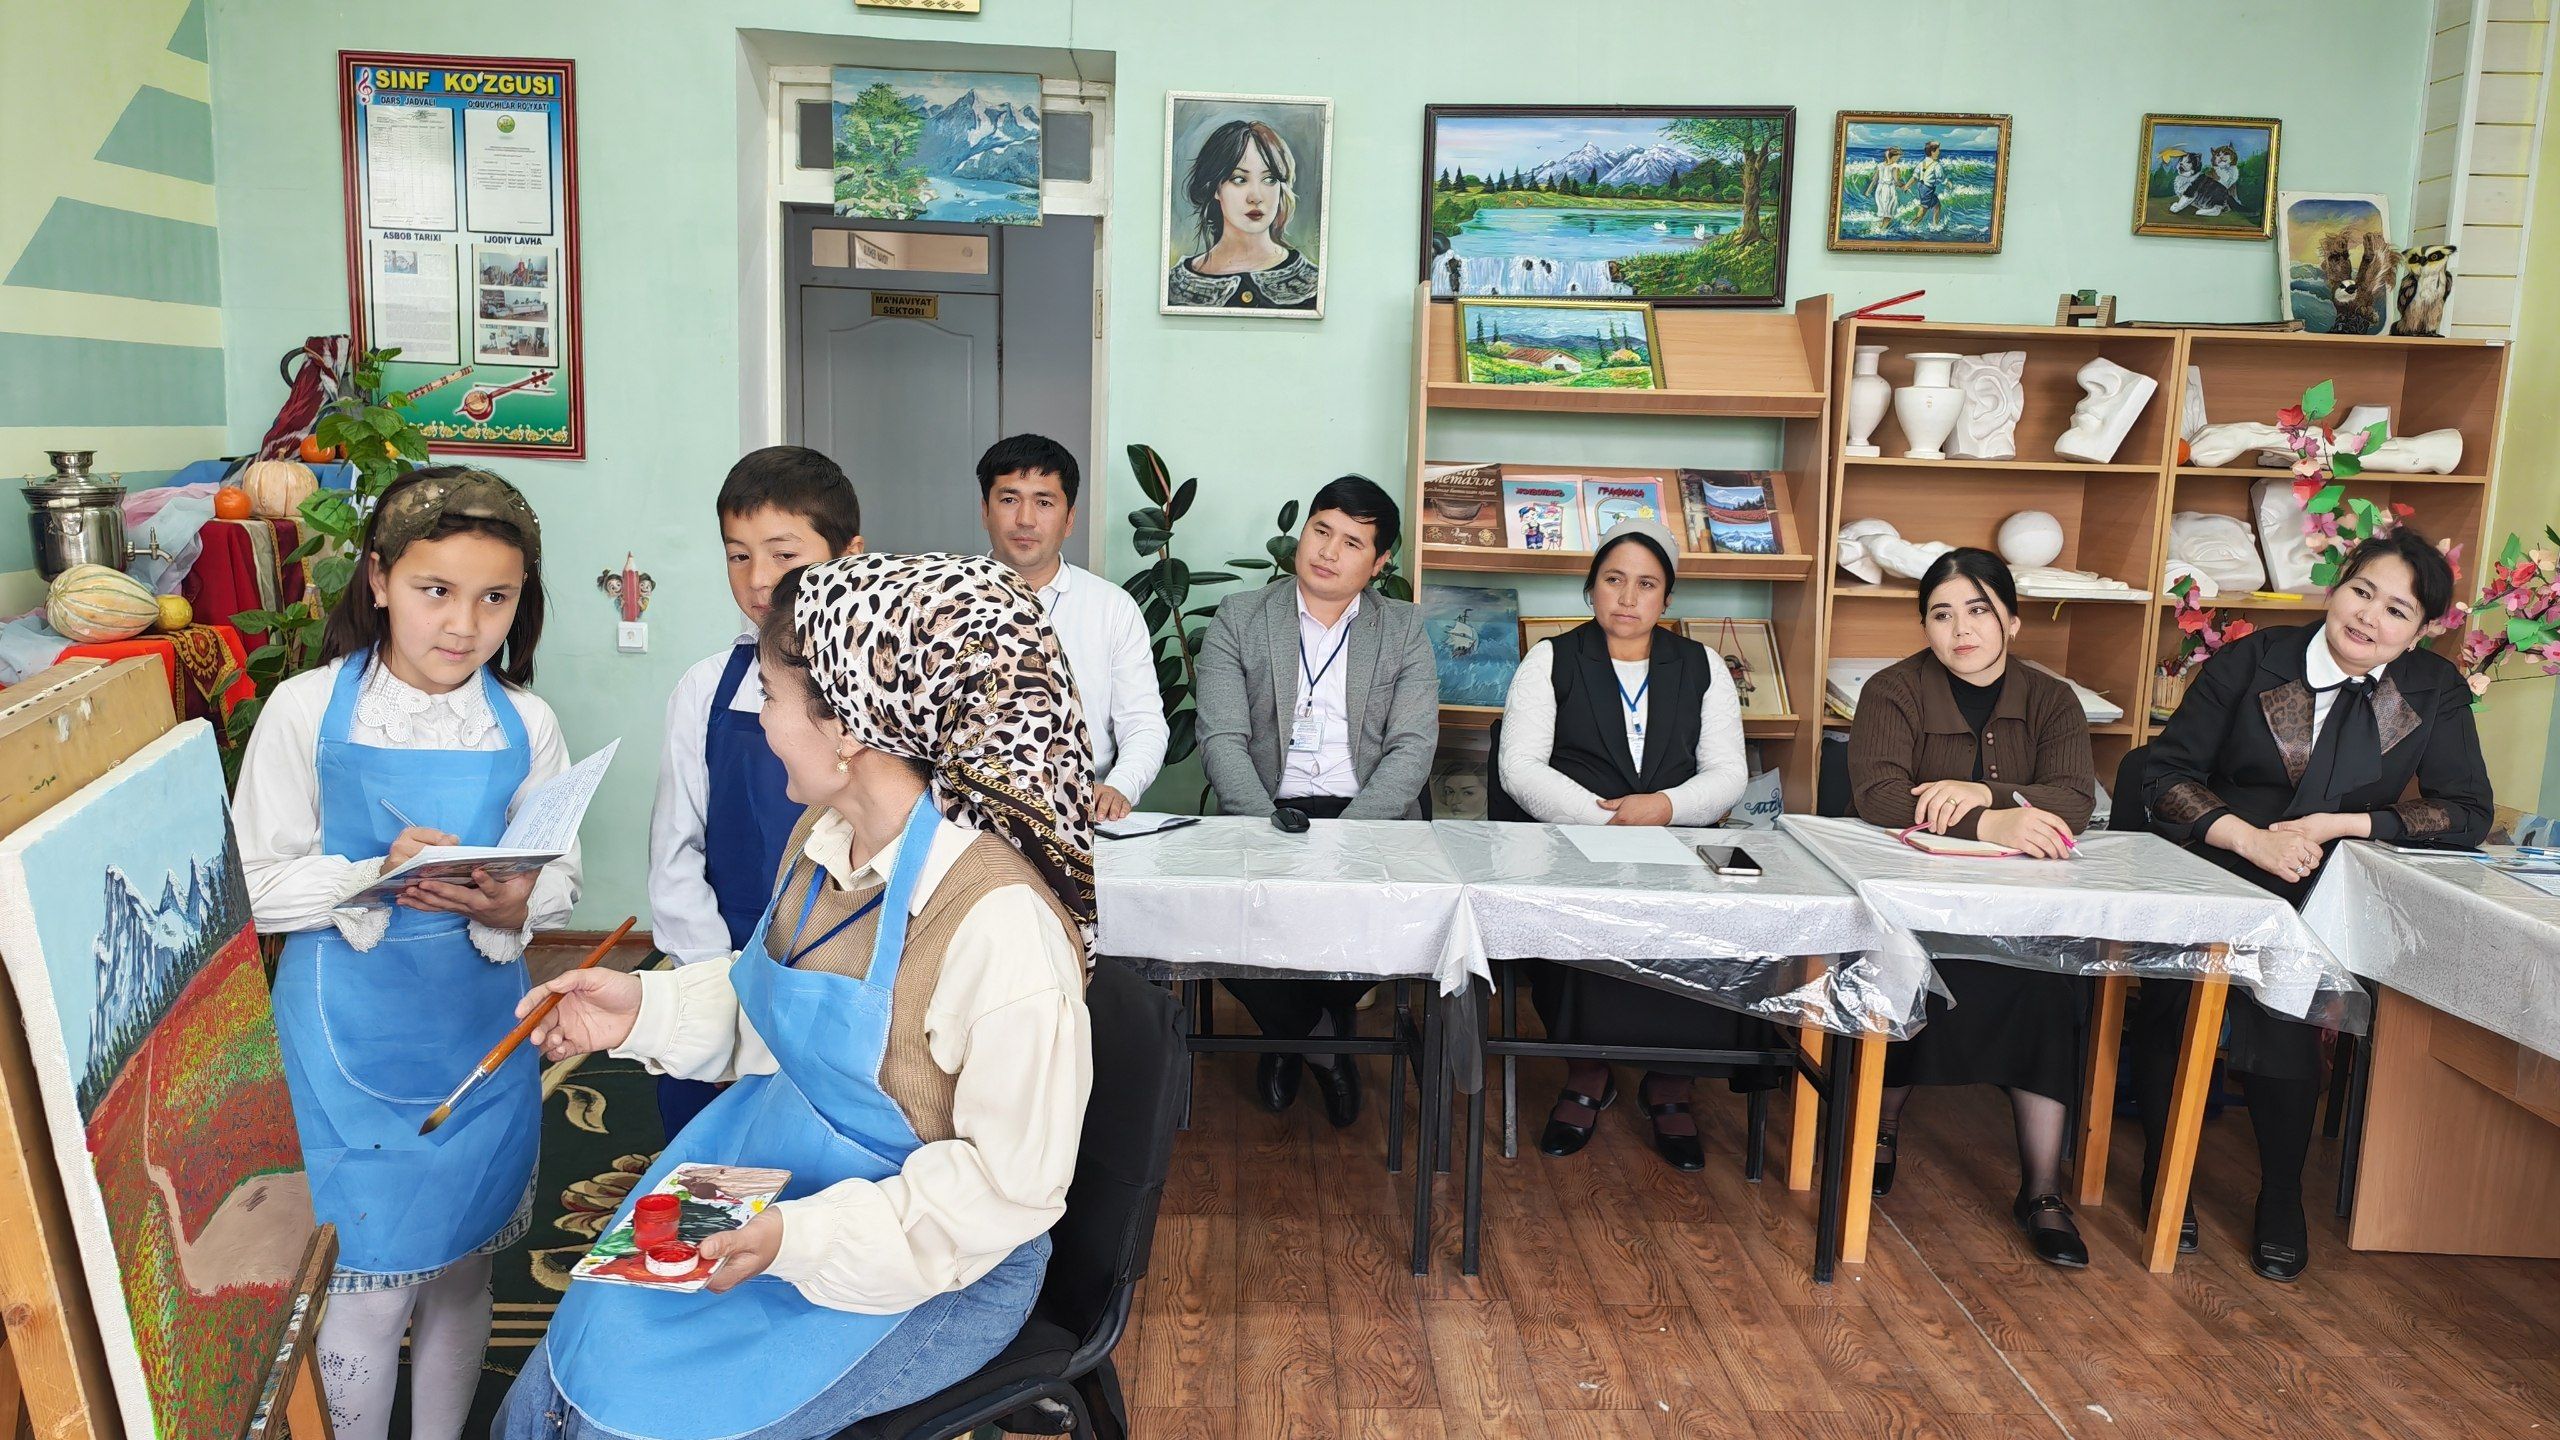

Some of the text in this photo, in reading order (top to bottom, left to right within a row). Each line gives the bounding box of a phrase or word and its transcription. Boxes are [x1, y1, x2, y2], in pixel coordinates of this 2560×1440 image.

[375, 69, 430, 90] SINF
[380, 96, 436, 106] DARS JADVALI
[383, 231, 442, 242] ASBOB TARIXI
[484, 235, 542, 246] IJODIY LAVHA
[883, 306, 925, 316] SEKTORI
